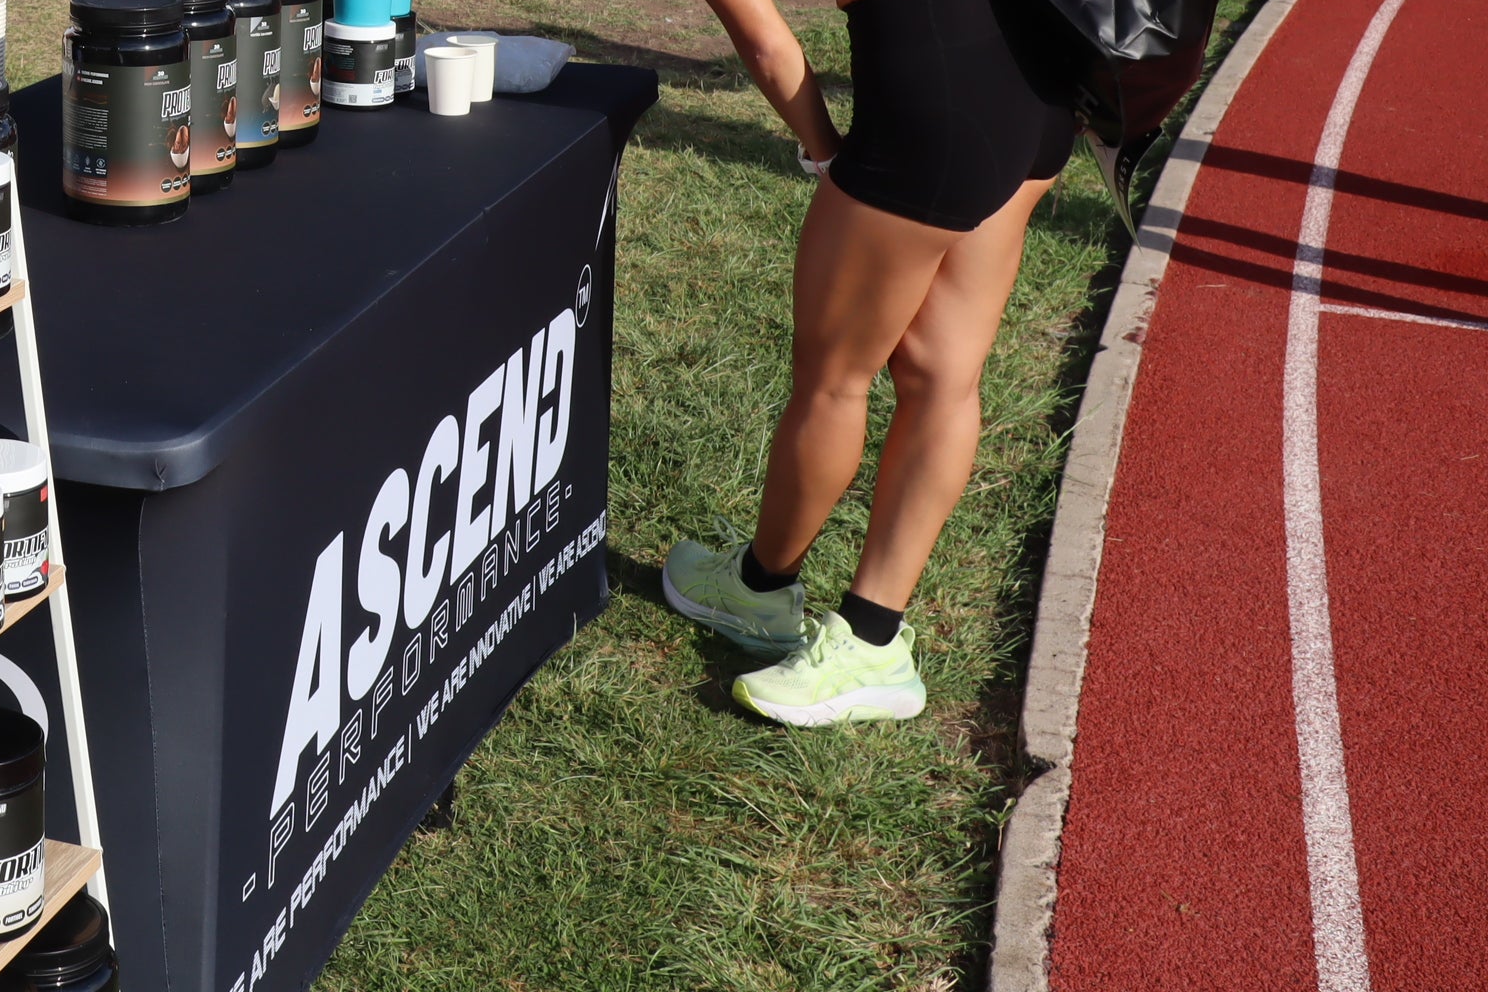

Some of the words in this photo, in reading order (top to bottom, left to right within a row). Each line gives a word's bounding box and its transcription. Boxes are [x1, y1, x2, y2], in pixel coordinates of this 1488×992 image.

[578, 282, 590, 309] TM
[267, 480, 561, 891] PERFORMANCE
[270, 307, 577, 822] ASCEND
[290, 735, 405, 928] PERFORMANCE
[416, 690, 439, 740] WE
[441, 656, 468, 713] ARE
[469, 583, 532, 678] INNOVATIVE
[538, 558, 555, 595] WE
[556, 539, 575, 580] ARE
[575, 508, 607, 563] ASCEND
